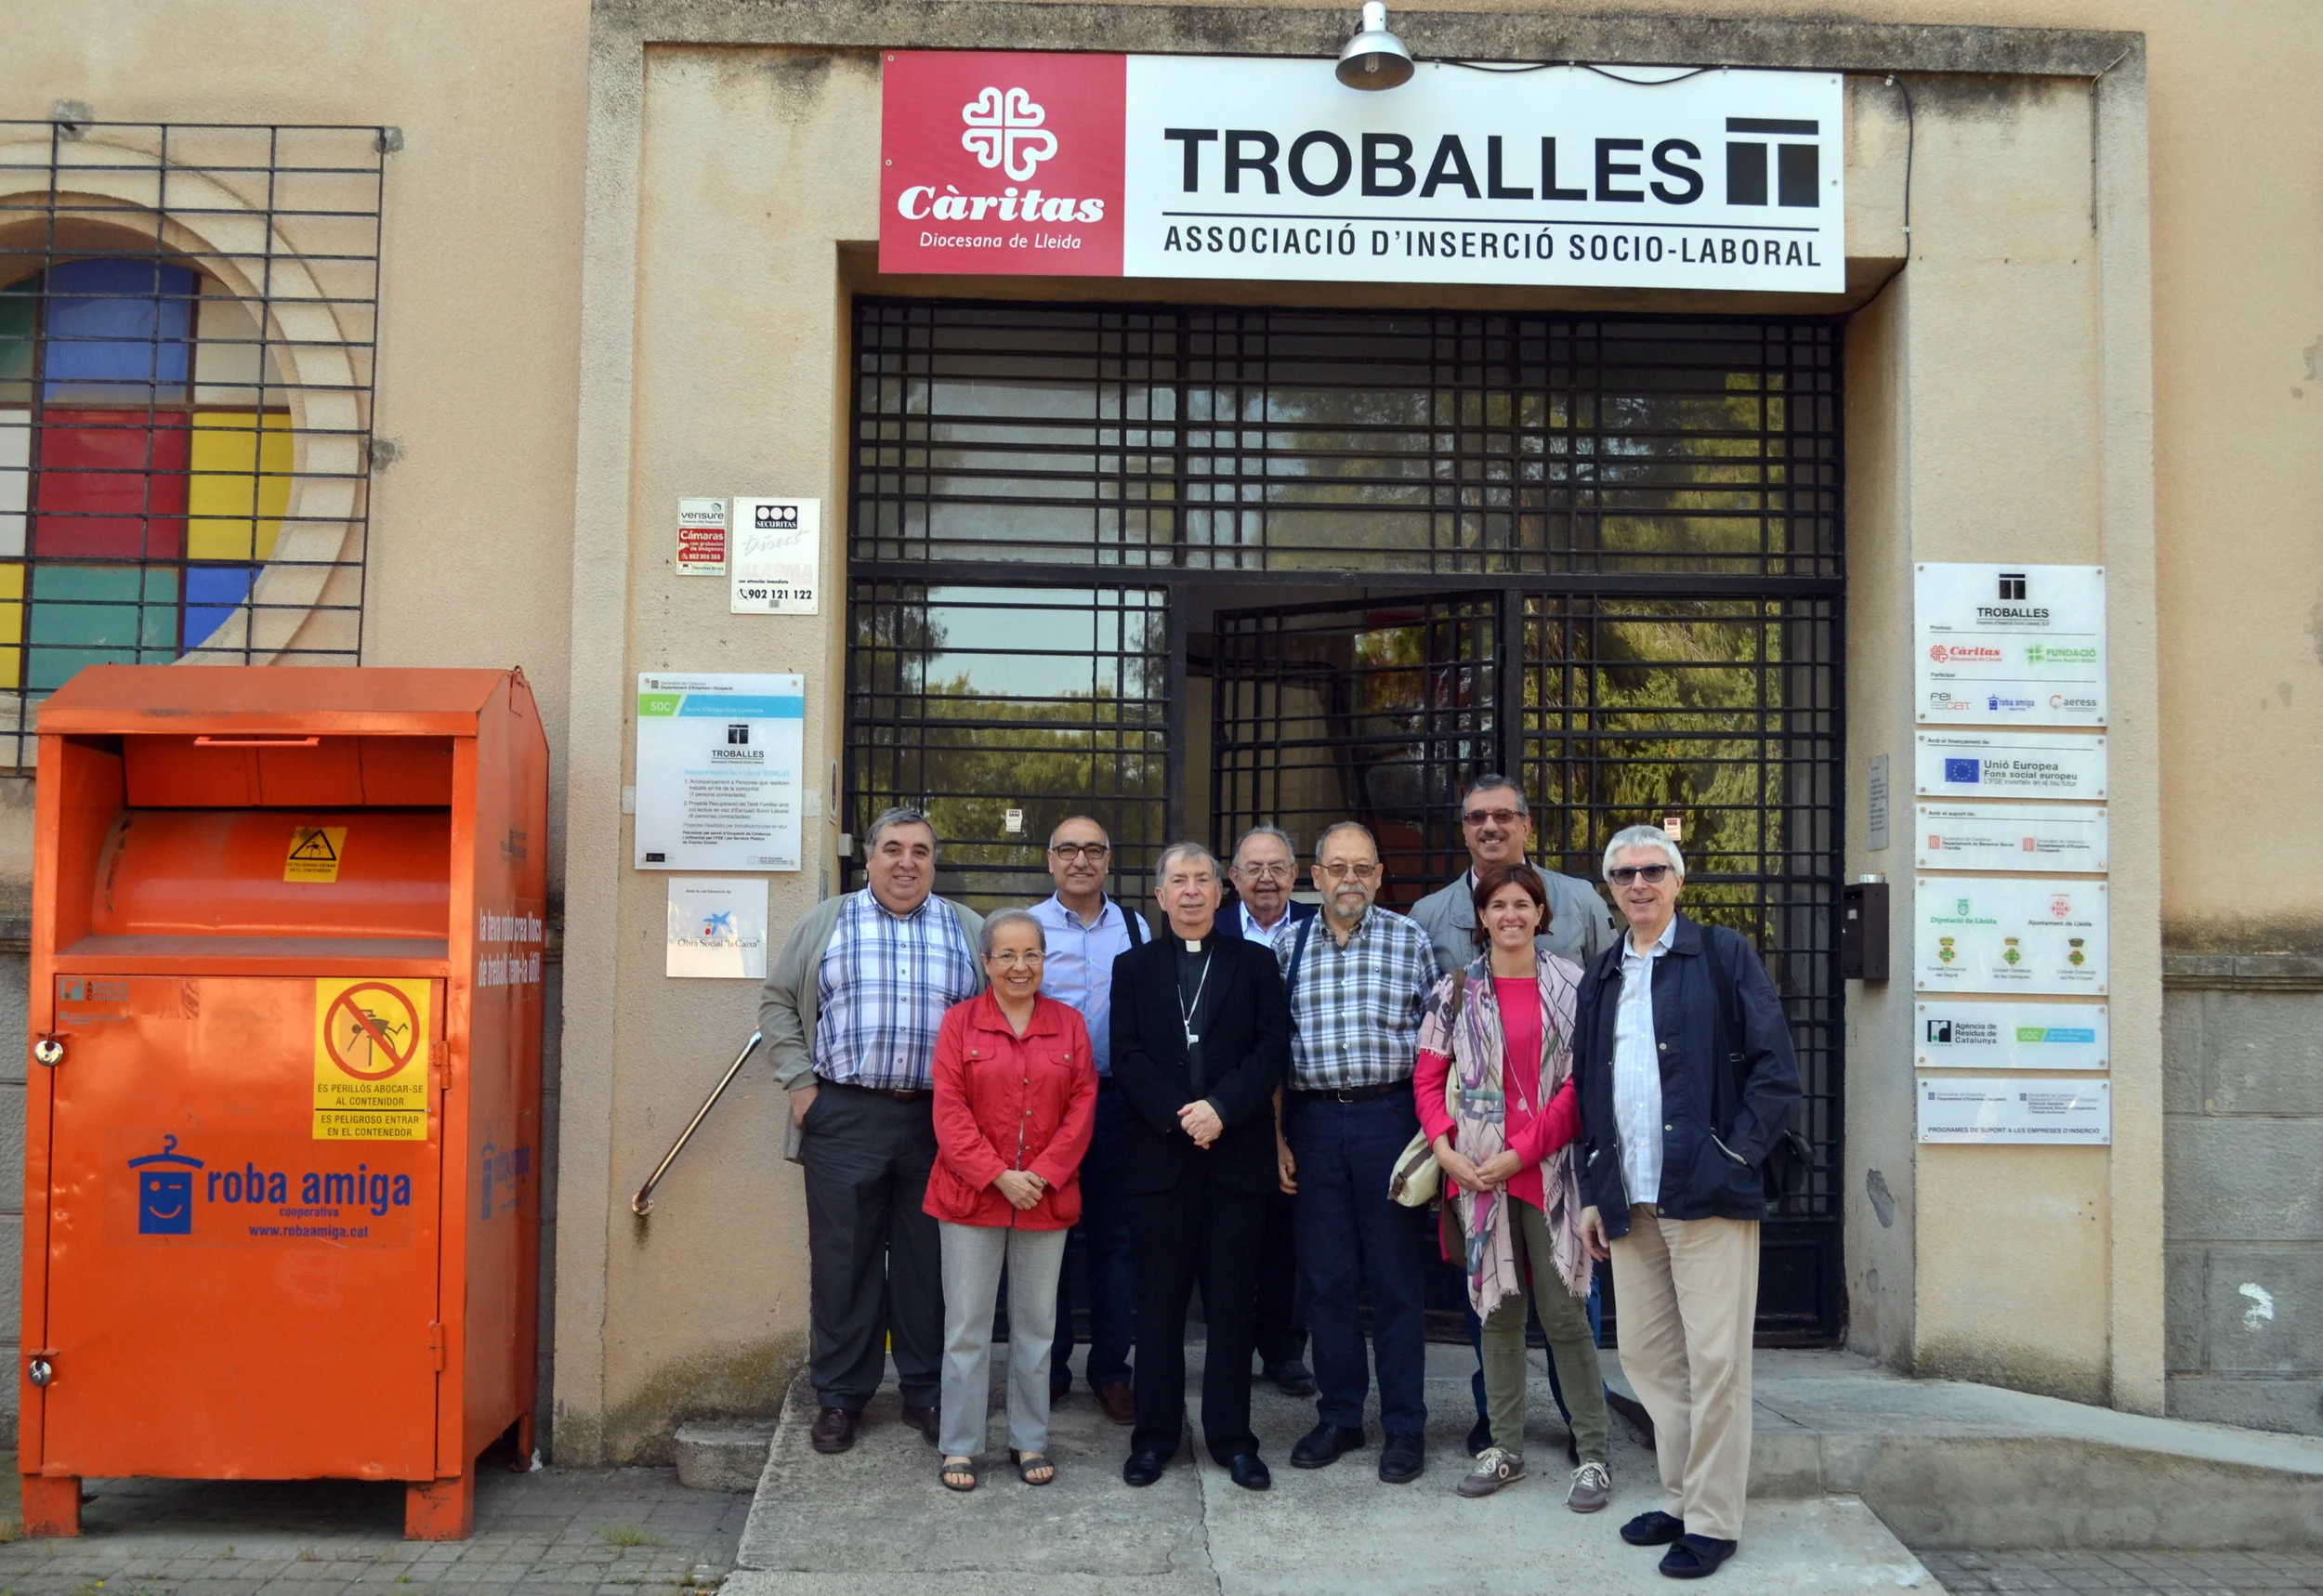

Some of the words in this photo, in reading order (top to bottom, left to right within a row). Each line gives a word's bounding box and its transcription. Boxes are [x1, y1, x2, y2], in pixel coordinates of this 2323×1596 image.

[1164, 128, 1704, 205] TROBALLES
[898, 184, 1105, 223] Càritas
[920, 231, 1003, 248] Diocesana
[1009, 233, 1028, 249] de
[1034, 233, 1082, 249] Lleida
[1163, 222, 1356, 256] ASSOCIACIÓ
[1371, 227, 1554, 260] D'INSERCIÓ
[1569, 233, 1821, 268] SOCIO-LABORAL
[680, 530, 724, 541] Cámaras
[742, 529, 810, 556] Direct
[748, 589, 768, 599] 902
[771, 589, 788, 599] 121
[794, 589, 812, 599] 122
[1976, 608, 2049, 618] TROBALLES
[1949, 647, 2001, 656] Càritas
[2046, 647, 2096, 657] FUNDACIÓ
[650, 701, 671, 711] SOC
[2015, 700, 2035, 708] amiga
[712, 750, 765, 758] TROBALLES
[1984, 760, 2009, 769] Unió
[2014, 761, 2058, 772] Europea
[1984, 770, 2006, 778] Fons
[2039, 773, 2078, 781] europeu
[479, 907, 487, 942] la
[488, 909, 500, 942] teva
[515, 917, 527, 942] crea
[528, 910, 542, 942] llocs
[677, 938, 698, 947] Obra
[700, 938, 723, 947] Social
[479, 952, 487, 988] de
[1955, 1022, 1985, 1030] Agència
[1955, 1037, 1997, 1045] Catalunya
[374, 1084, 424, 1093] ABOCAR-SE
[335, 1097, 346, 1105] AL
[349, 1097, 404, 1105] CONTENIDOR
[321, 1115, 332, 1124] ES
[335, 1115, 382, 1124] PELIGROSO
[385, 1115, 419, 1124] ENTRAR
[327, 1128, 338, 1136] EN
[342, 1128, 351, 1136] EL
[355, 1128, 413, 1136] CONTENEDOR
[207, 1161, 287, 1204] roba
[302, 1163, 411, 1217] amiga
[279, 1207, 339, 1219] cooperativa
[248, 1224, 369, 1239] www.robaamiga.cat
